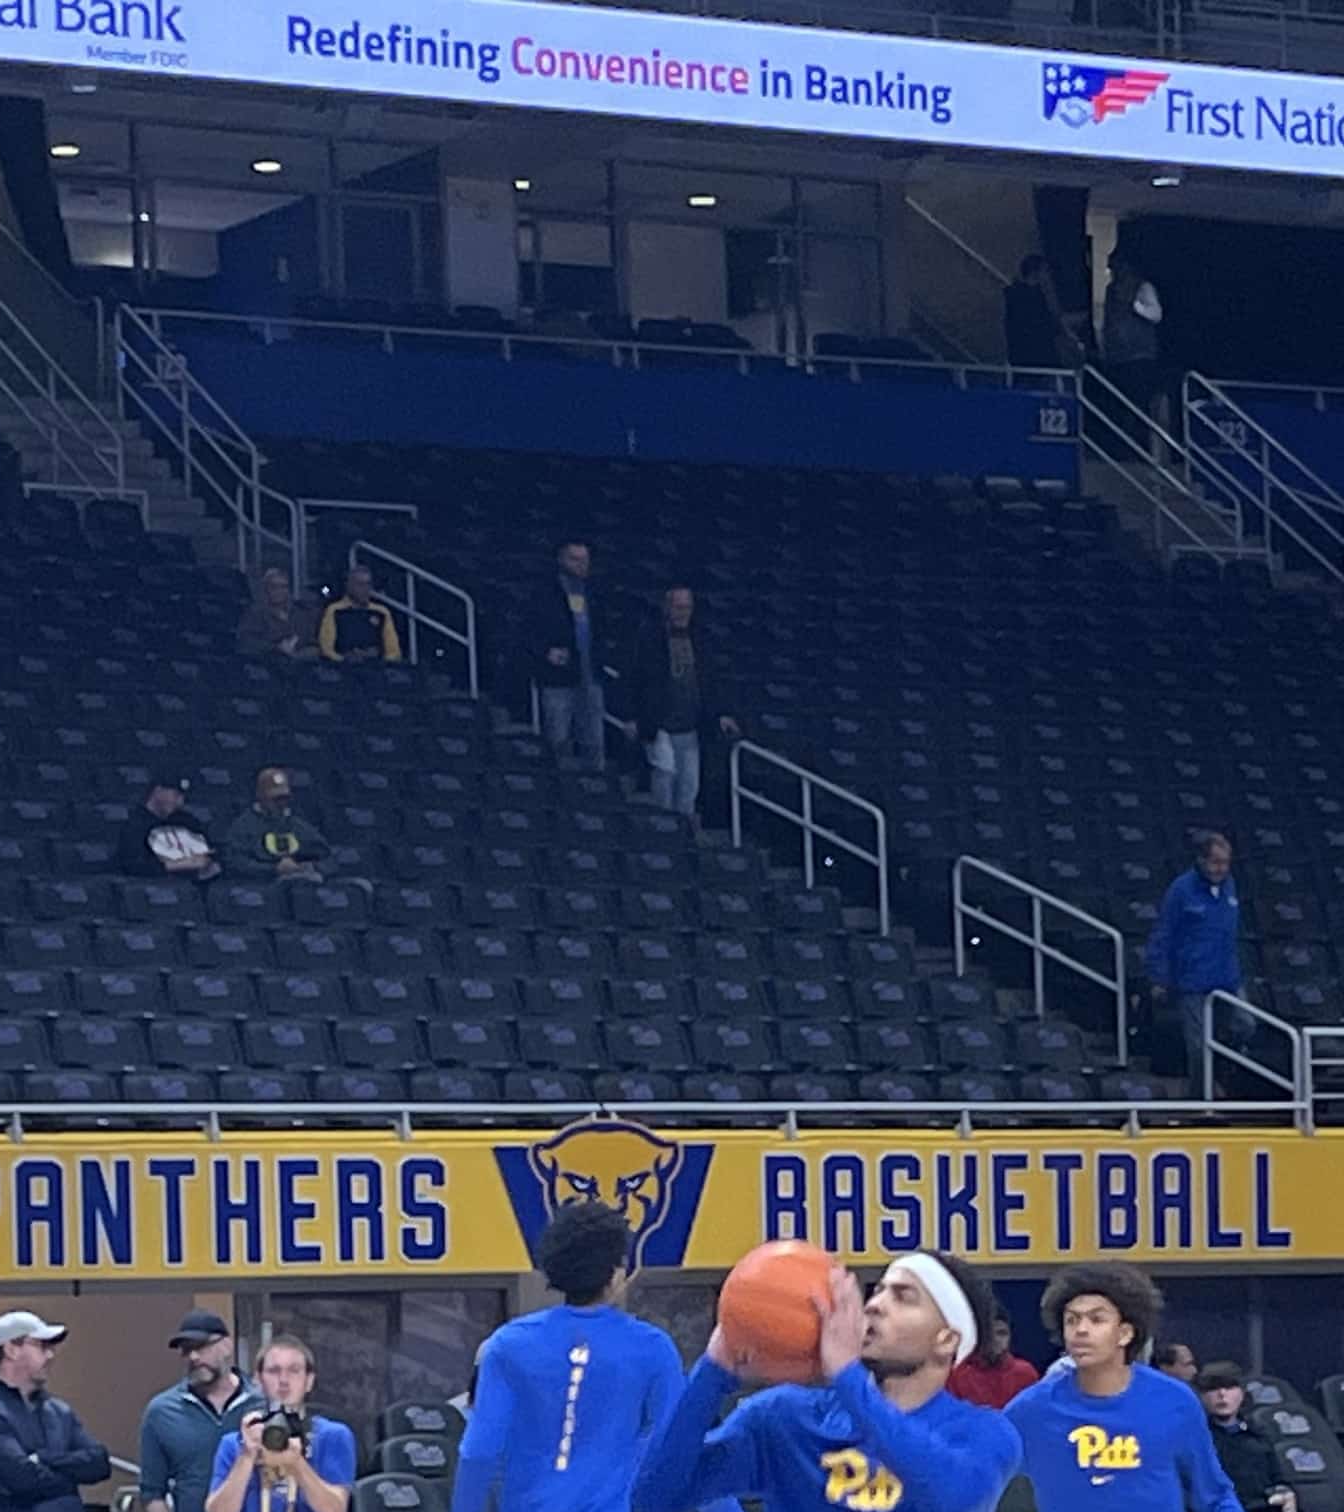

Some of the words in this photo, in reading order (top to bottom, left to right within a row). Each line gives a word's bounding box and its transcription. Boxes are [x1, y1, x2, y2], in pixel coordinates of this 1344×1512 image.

[54, 0, 187, 42] Bank
[287, 15, 500, 83] Redefining
[511, 36, 749, 95] Convenience
[759, 59, 793, 99] in
[805, 64, 953, 124] Banking
[1165, 88, 1245, 139] First
[763, 1149, 1294, 1254] BASKETBALL
[1068, 1424, 1142, 1469] Pitt
